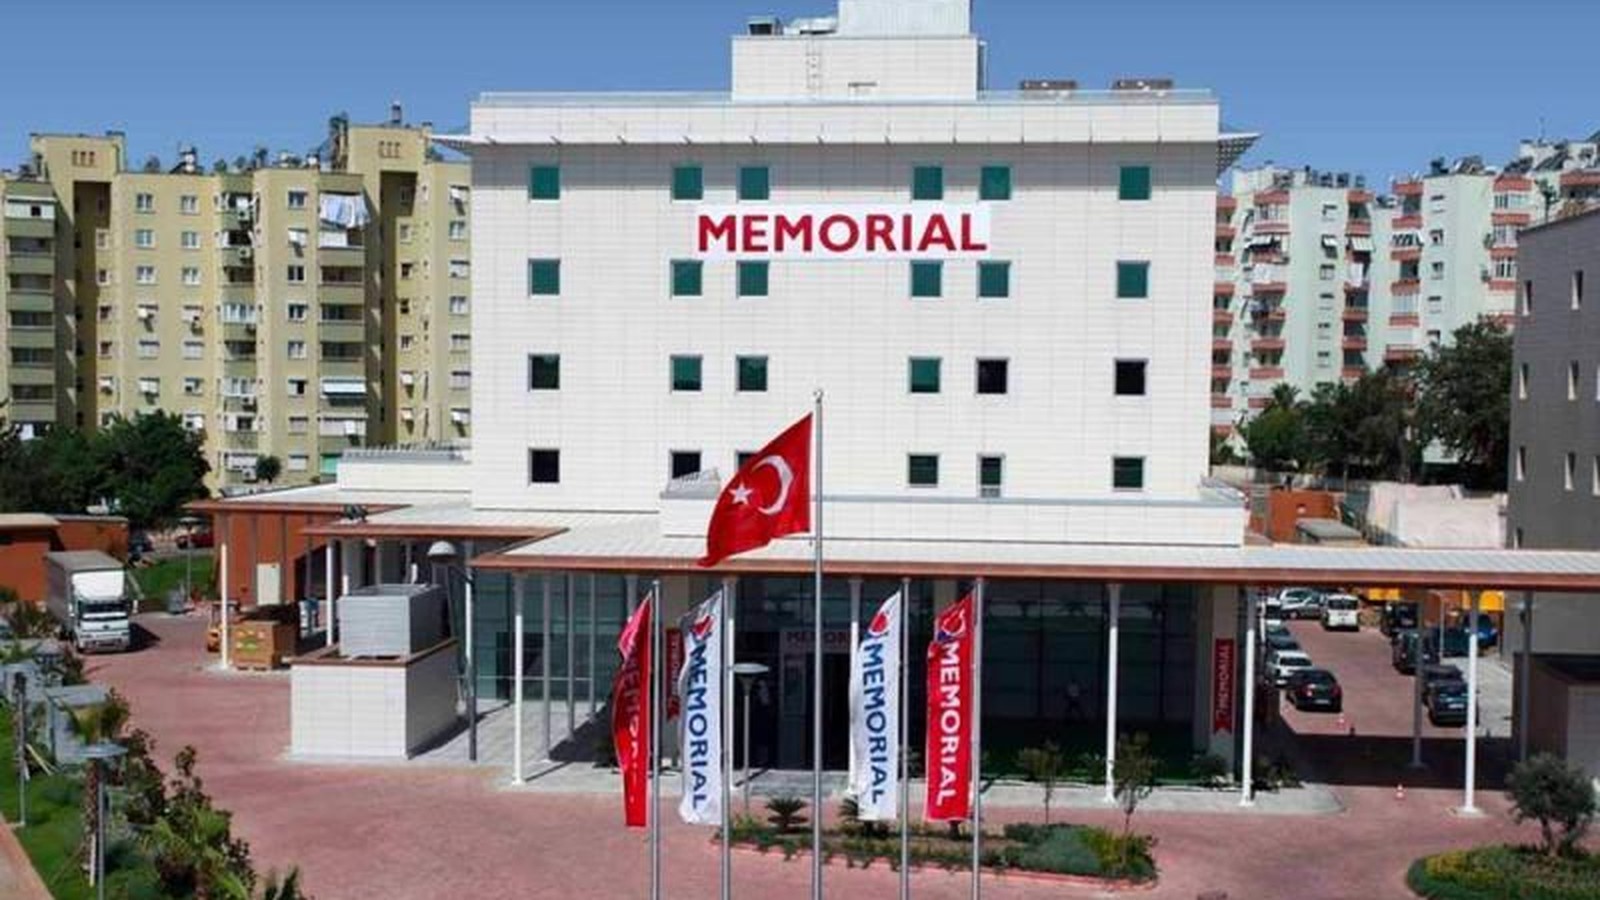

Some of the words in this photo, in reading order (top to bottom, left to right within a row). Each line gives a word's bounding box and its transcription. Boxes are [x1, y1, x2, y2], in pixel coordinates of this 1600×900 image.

[698, 213, 987, 252] MEMORIAL
[686, 643, 708, 810] MEMORIAL
[863, 642, 887, 804] MEMORIAL
[936, 641, 960, 806] MEMORIAL
